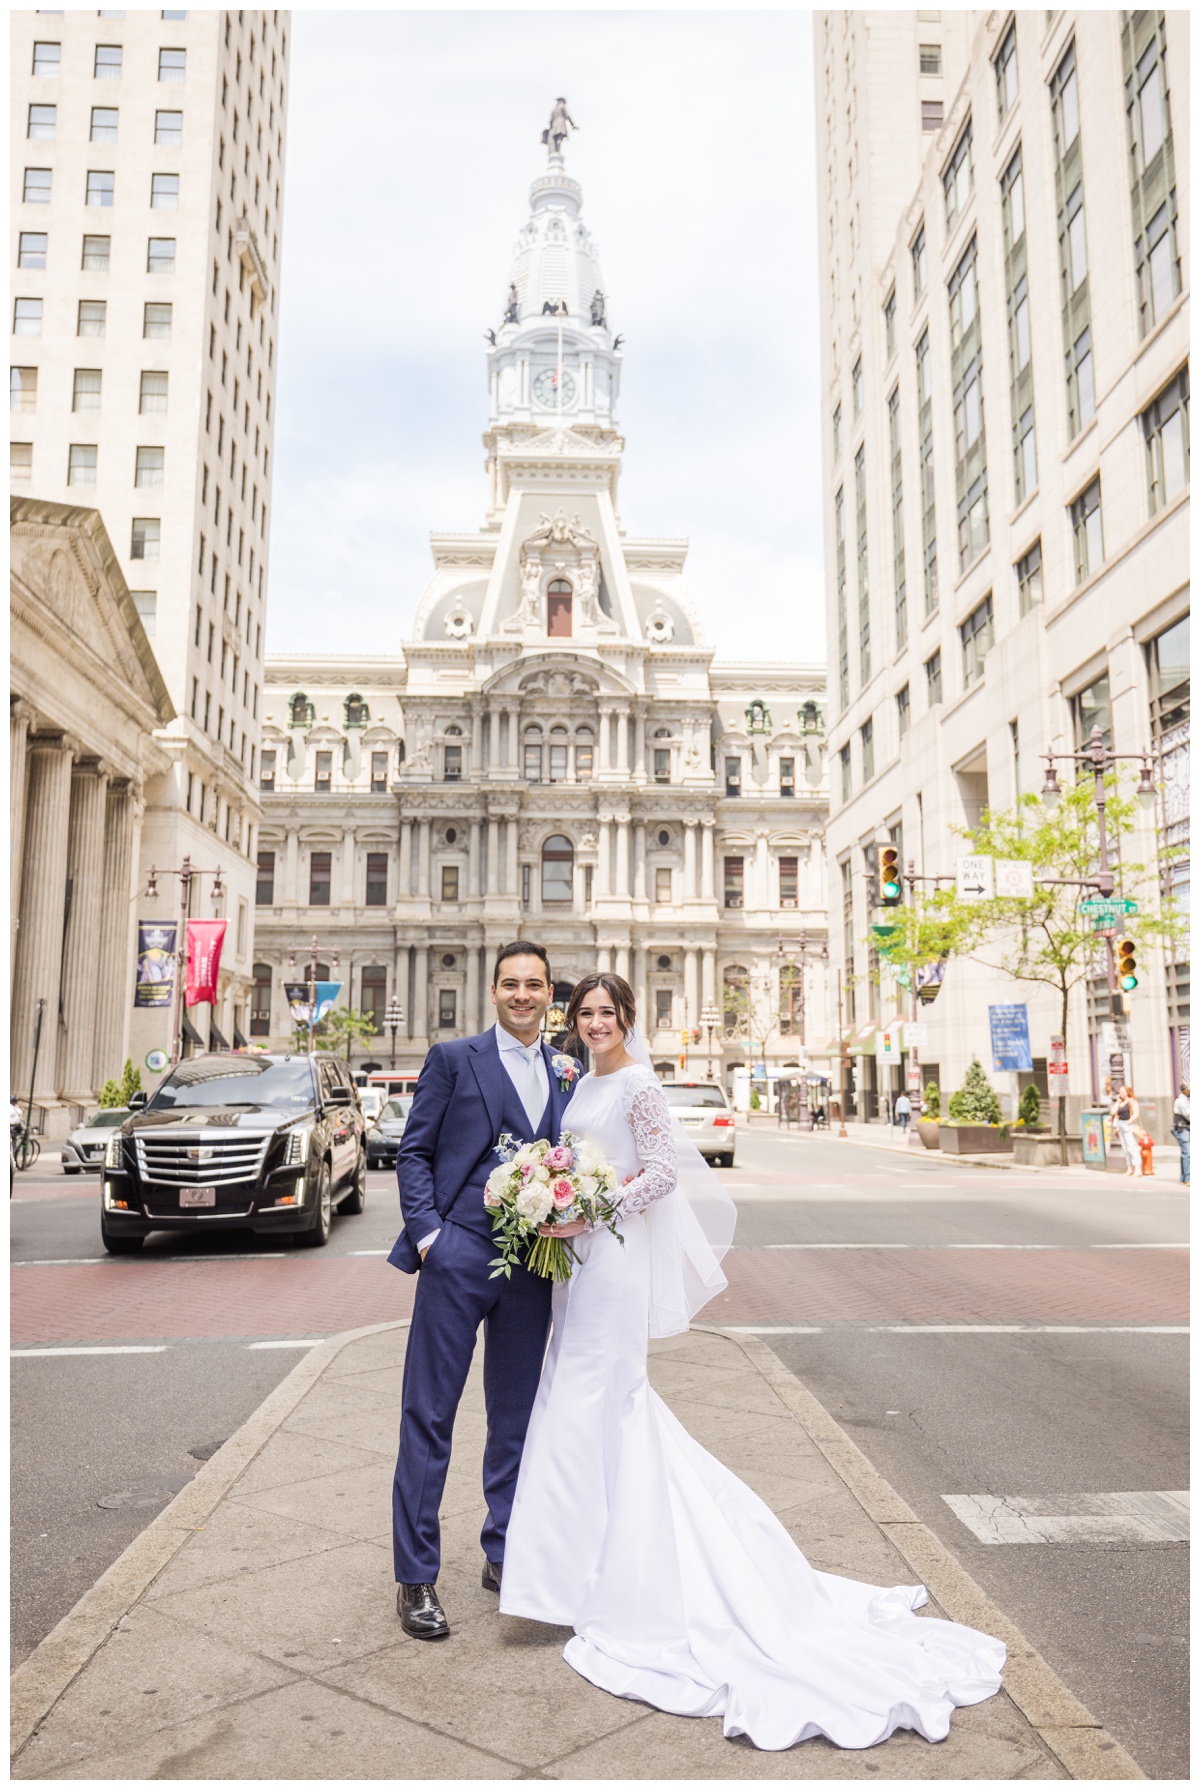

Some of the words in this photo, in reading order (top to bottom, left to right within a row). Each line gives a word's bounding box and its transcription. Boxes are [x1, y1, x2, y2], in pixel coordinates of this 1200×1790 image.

[963, 859, 985, 869] ONE
[963, 871, 985, 880] WAY
[1000, 887, 1011, 895] THE
[1016, 887, 1030, 895] BOX
[1081, 904, 1127, 914] CHESTNUT
[194, 940, 202, 988] ADVANCING
